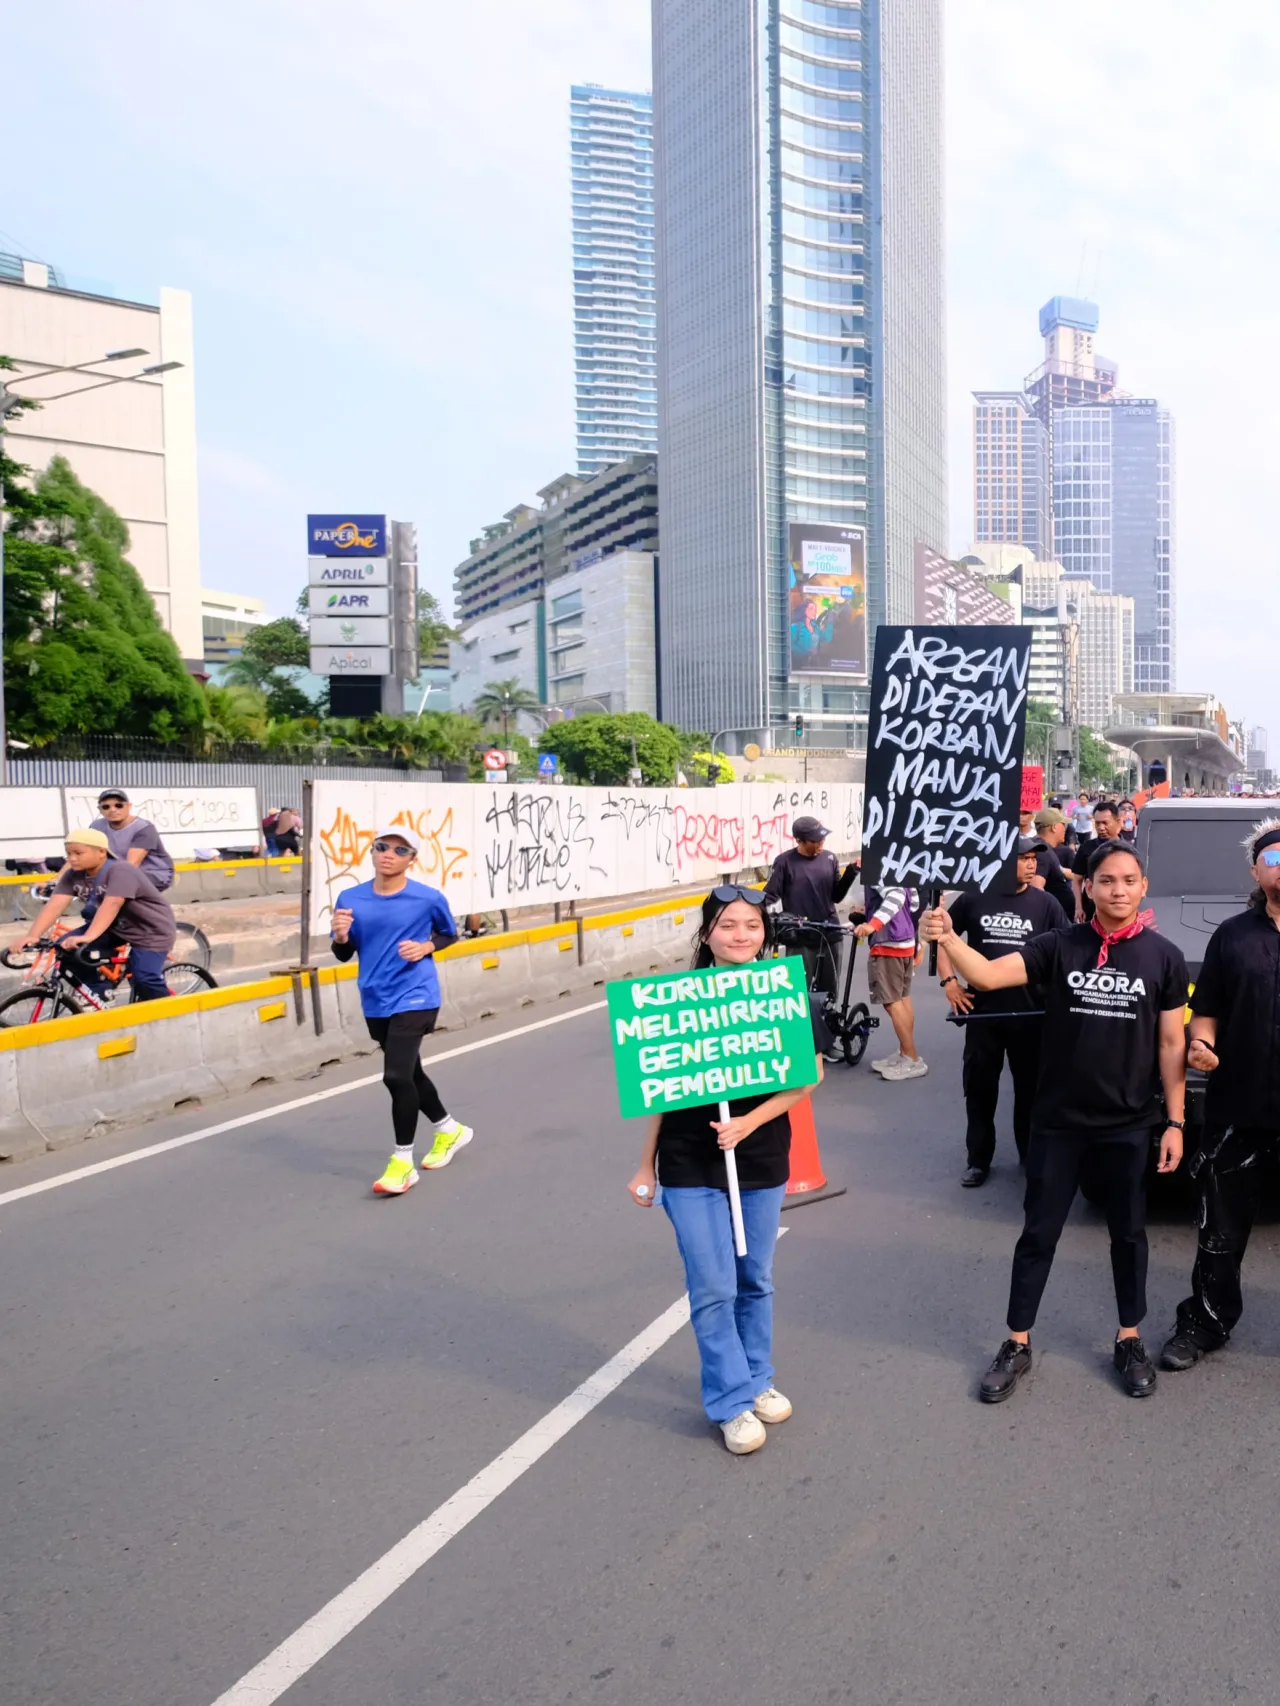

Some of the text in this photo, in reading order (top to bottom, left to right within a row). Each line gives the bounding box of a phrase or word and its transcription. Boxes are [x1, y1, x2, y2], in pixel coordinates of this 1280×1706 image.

[321, 569, 365, 579] APRIL
[338, 595, 369, 607] APR
[329, 653, 372, 672] Apical
[885, 629, 1031, 690] AROGAN
[911, 679, 1026, 725] DEPAN
[874, 713, 1018, 770] KORBAN,
[887, 751, 1002, 812] MANJA
[904, 798, 1019, 860] DEPAN
[878, 842, 1002, 894] HAKIM
[980, 914, 1034, 932] OZORA
[631, 965, 793, 1009] KORUPTOR
[1067, 970, 1147, 996] OZORA
[616, 992, 808, 1045] MELAHIRKAN
[638, 1027, 782, 1074] GENERASI
[640, 1056, 791, 1108] PEMBULLY
